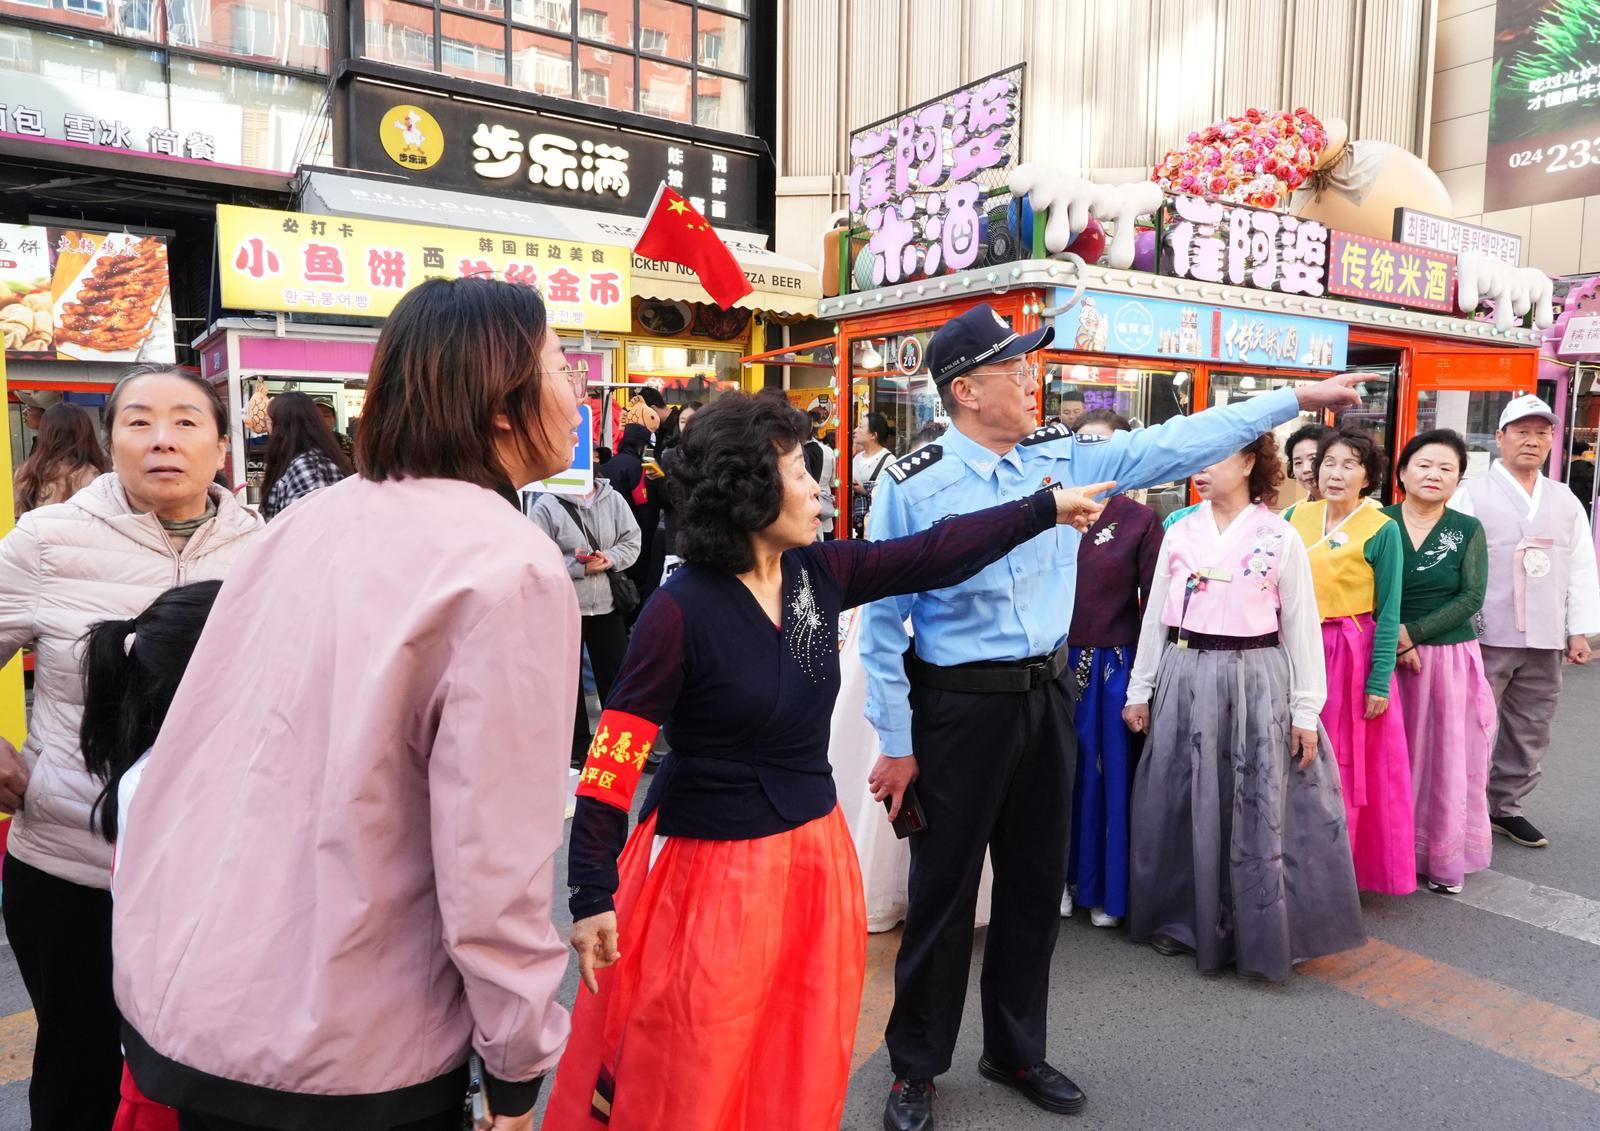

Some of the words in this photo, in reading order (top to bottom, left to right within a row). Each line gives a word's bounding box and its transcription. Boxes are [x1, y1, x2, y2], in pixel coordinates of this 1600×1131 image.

[1528, 83, 1600, 110] 才懂黑牛
[1529, 64, 1600, 92] 吃过火炉
[64, 113, 131, 148] 雪冰
[149, 126, 217, 161] 简餐
[850, 77, 1010, 212] 崔阿婆
[472, 123, 630, 198] 步乐满
[1509, 148, 1544, 168] 024
[56, 235, 141, 258] 火辣鸡爪
[282, 217, 354, 238] 必打卡
[869, 181, 980, 286] 米酒
[1172, 194, 1328, 297] 崔阿婆
[235, 238, 406, 288] 小鱼饼
[478, 237, 605, 264] 韩国街边美食
[631, 257, 669, 273] ICKEN
[772, 275, 802, 289] BEER
[1341, 241, 1448, 301] 传统米酒
